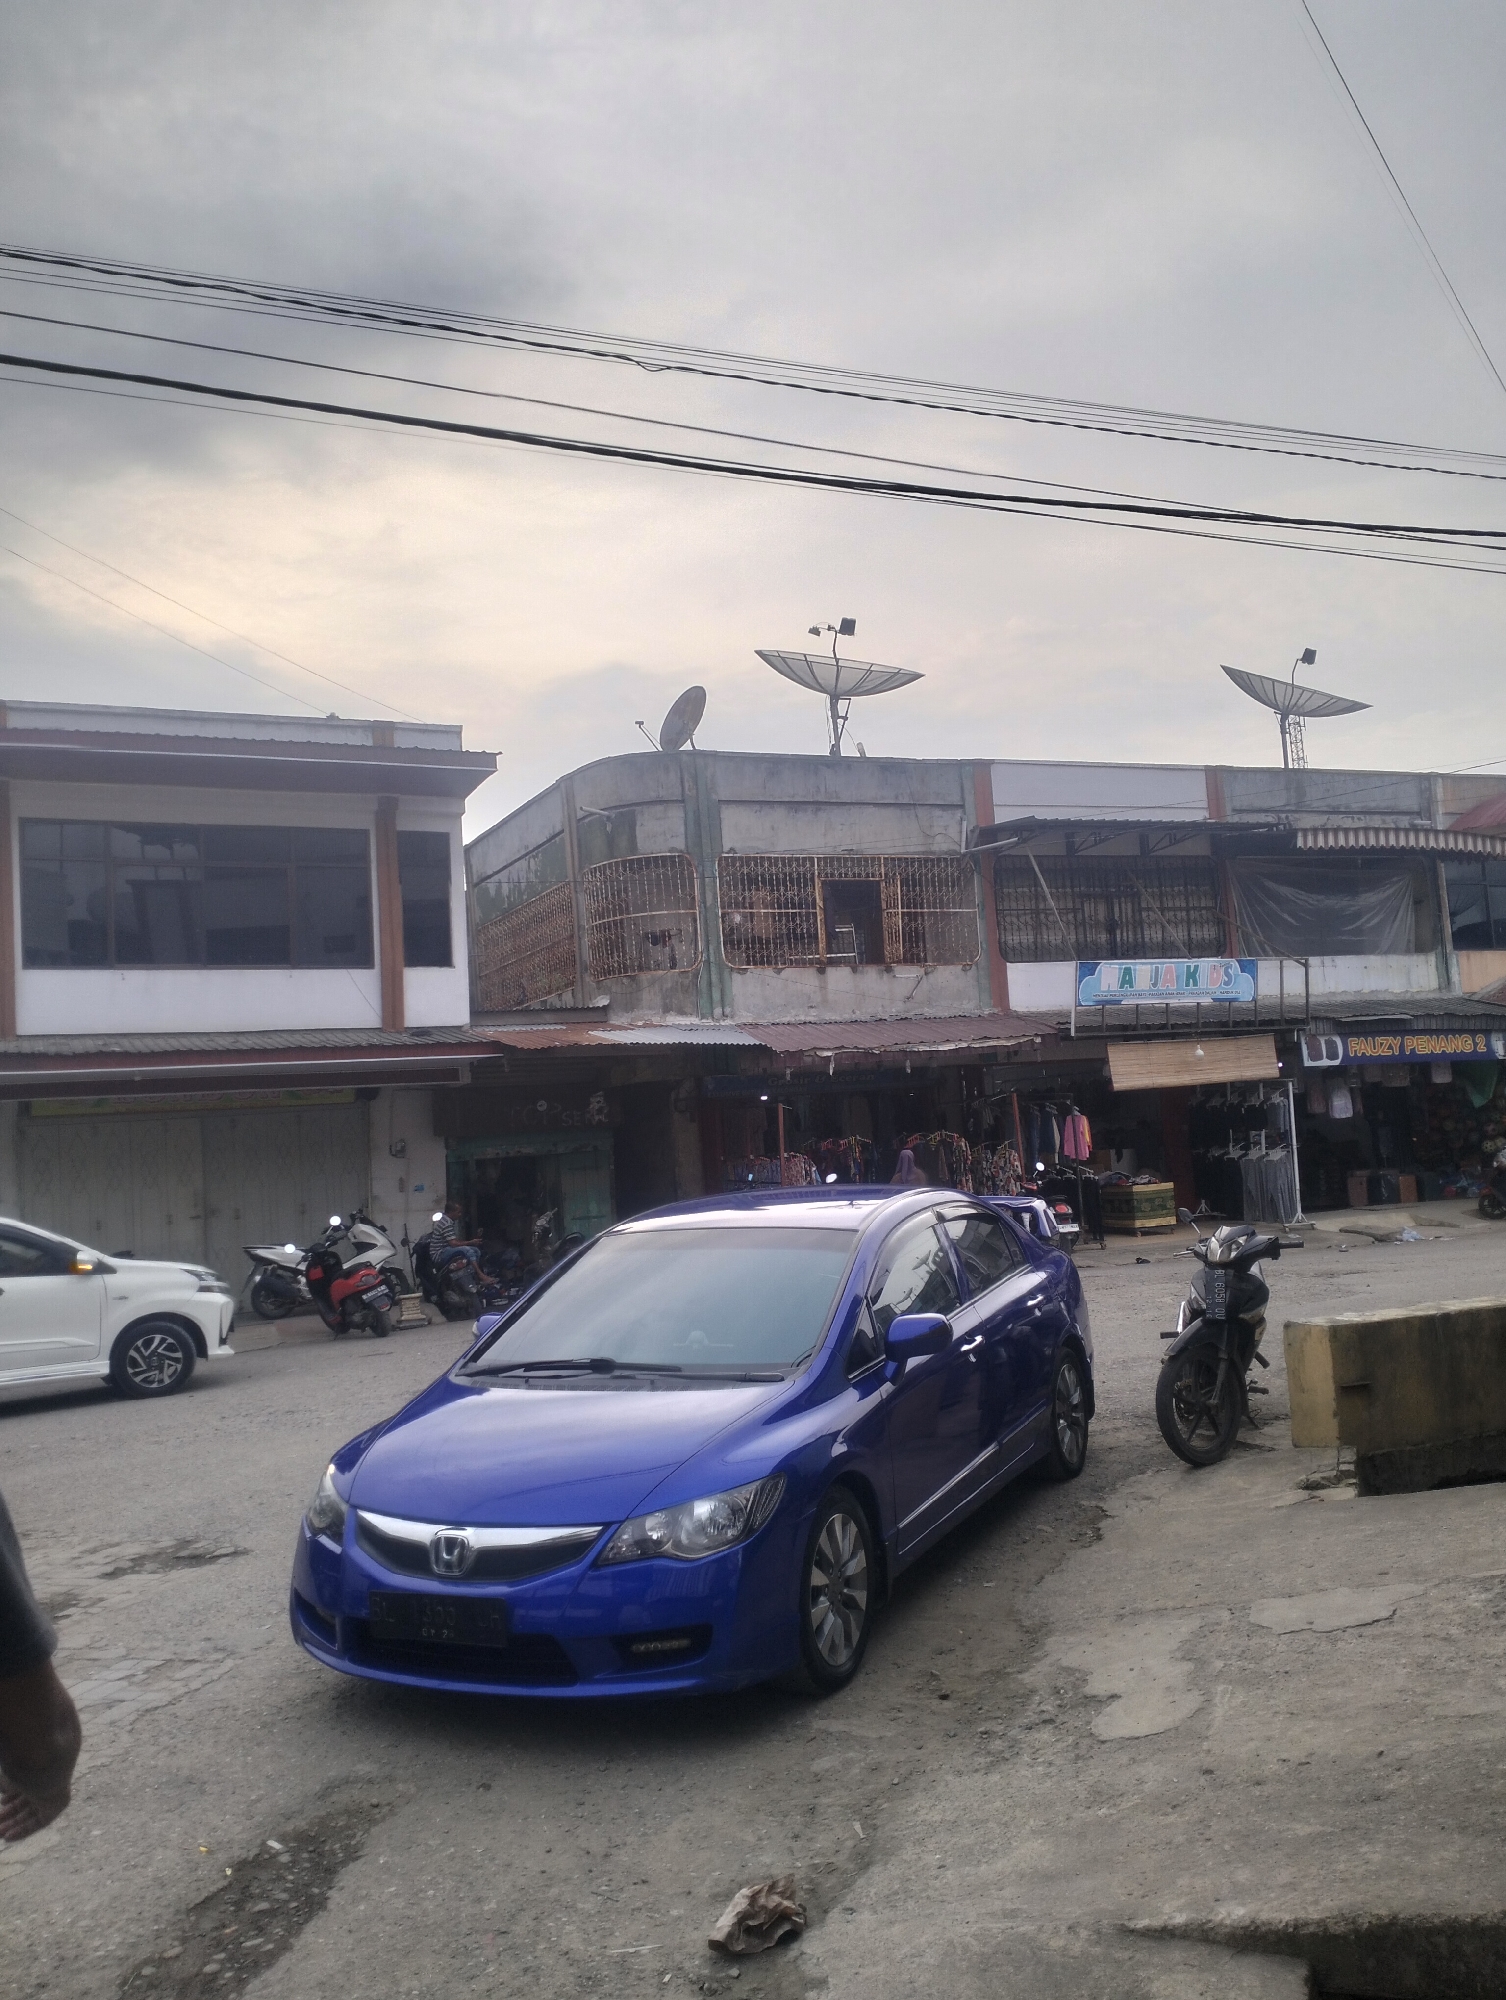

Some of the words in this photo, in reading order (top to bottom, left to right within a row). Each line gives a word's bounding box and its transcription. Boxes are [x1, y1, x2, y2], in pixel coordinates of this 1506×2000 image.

[1184, 962, 1234, 989] KIDS
[1348, 1037, 1401, 1056] FAUZY
[1404, 1034, 1473, 1054] PENANG
[1476, 1034, 1487, 1052] 2
[1215, 1269, 1225, 1278] BL
[1215, 1283, 1225, 1303] 6058
